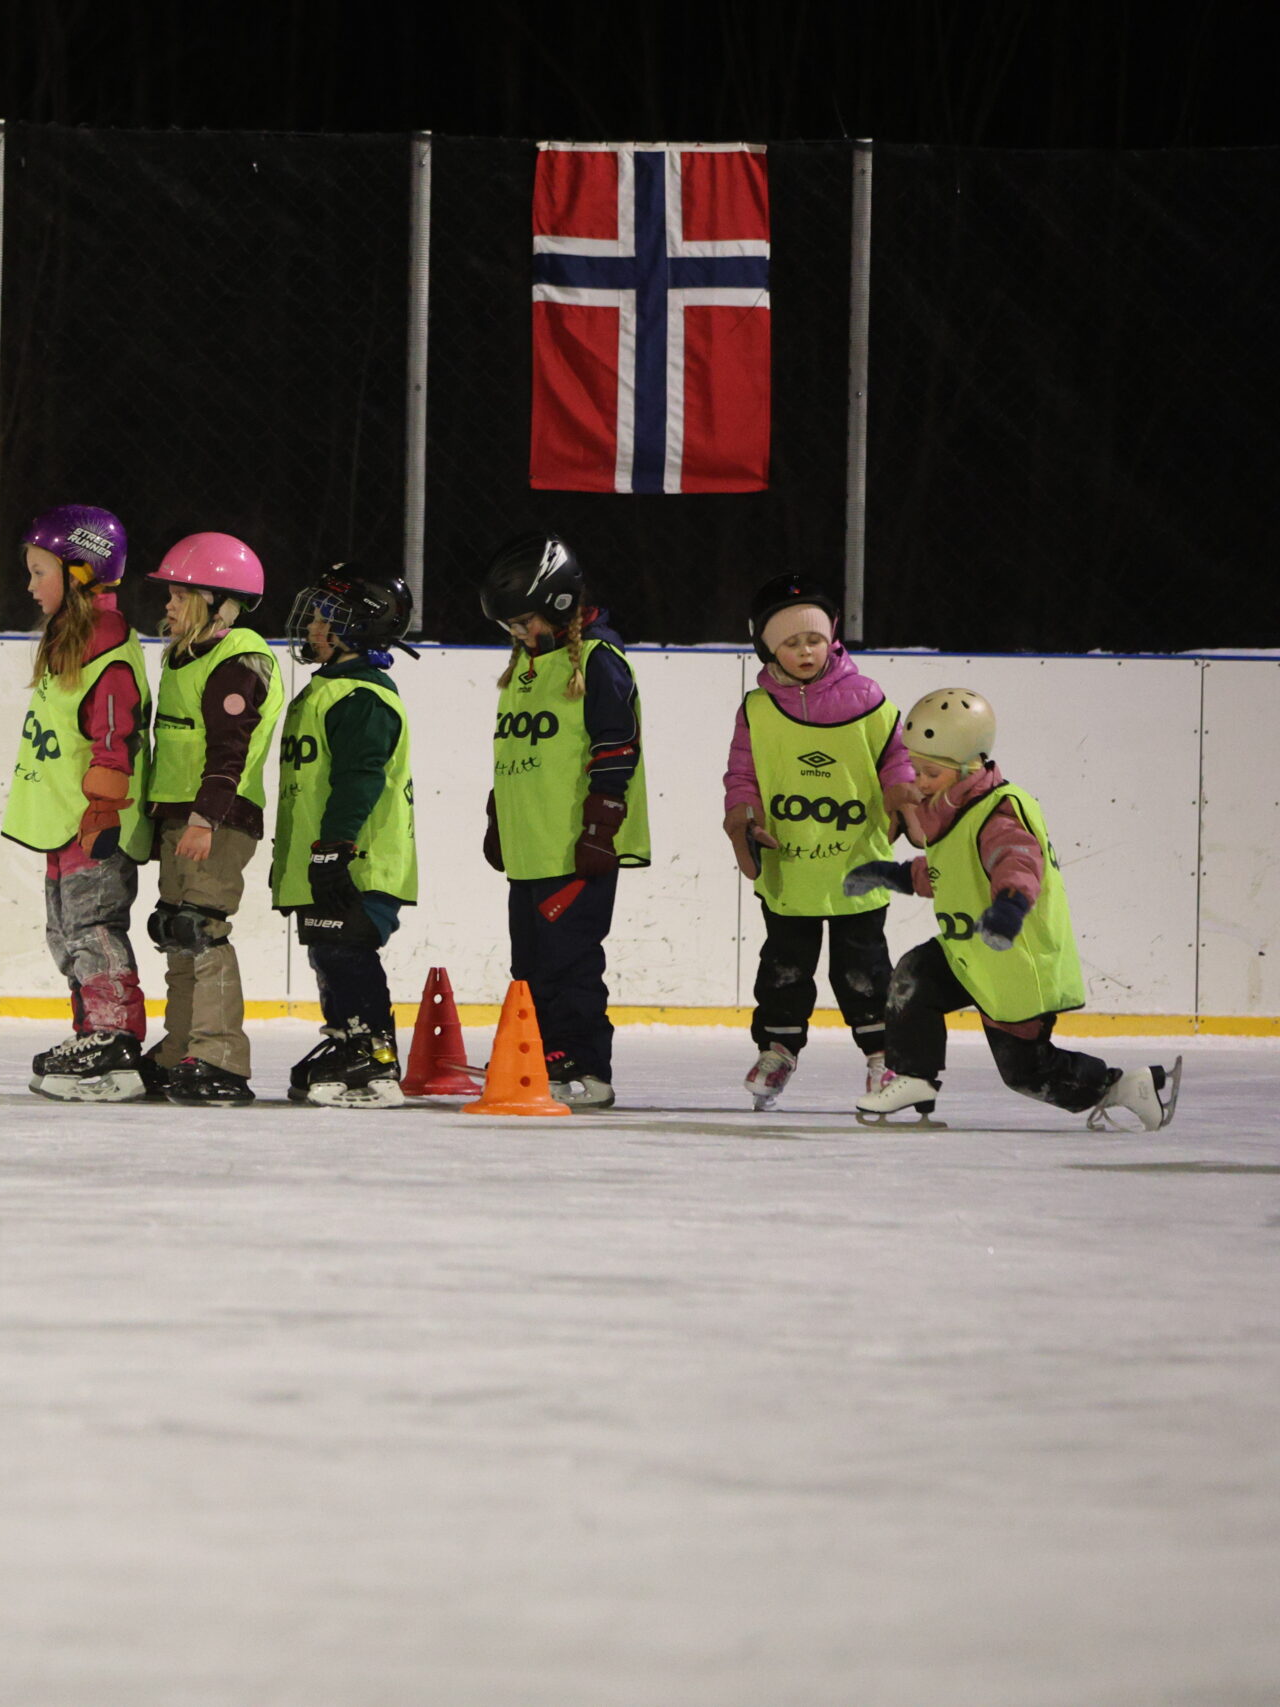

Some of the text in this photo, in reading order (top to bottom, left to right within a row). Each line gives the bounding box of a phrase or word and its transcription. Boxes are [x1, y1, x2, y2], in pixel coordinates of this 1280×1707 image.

[67, 534, 112, 559] RUNNER
[73, 527, 115, 549] STREET
[800, 769, 832, 778] umbro
[770, 793, 867, 831] coop
